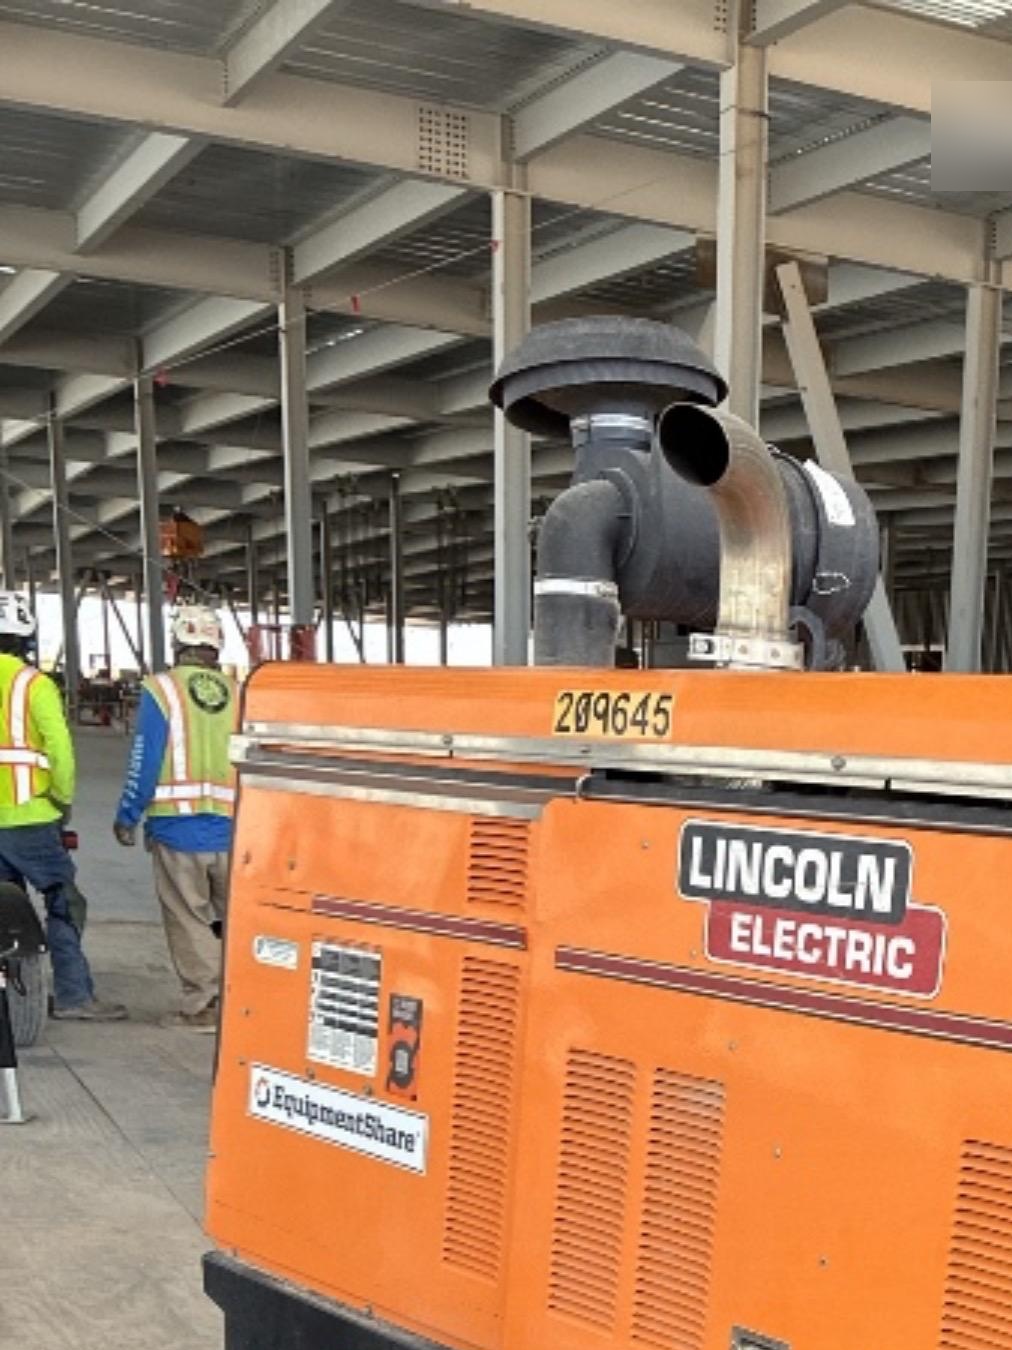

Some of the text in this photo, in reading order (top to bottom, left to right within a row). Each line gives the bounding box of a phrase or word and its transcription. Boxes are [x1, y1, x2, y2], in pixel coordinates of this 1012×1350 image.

[554, 692, 673, 737] 209645
[689, 836, 897, 913] LINCOLN
[730, 911, 917, 979] ELECTRIC
[272, 1085, 416, 1153] EquipmentShare
